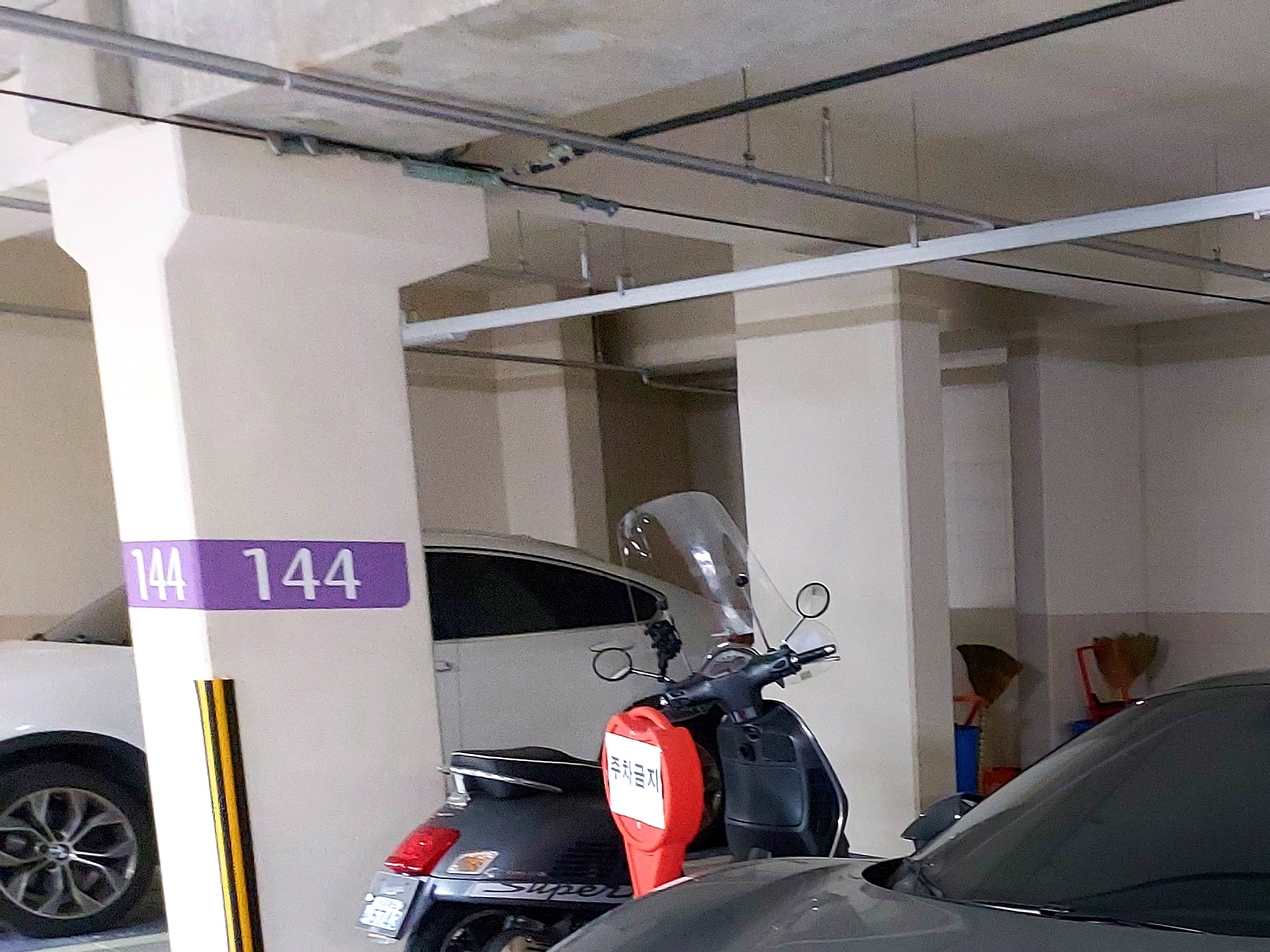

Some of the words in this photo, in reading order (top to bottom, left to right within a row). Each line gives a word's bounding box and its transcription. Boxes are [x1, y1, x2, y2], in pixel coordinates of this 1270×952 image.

[130, 547, 187, 601] 144
[243, 547, 362, 601] 144
[611, 755, 659, 793] 주차금지
[482, 879, 634, 901] Super
